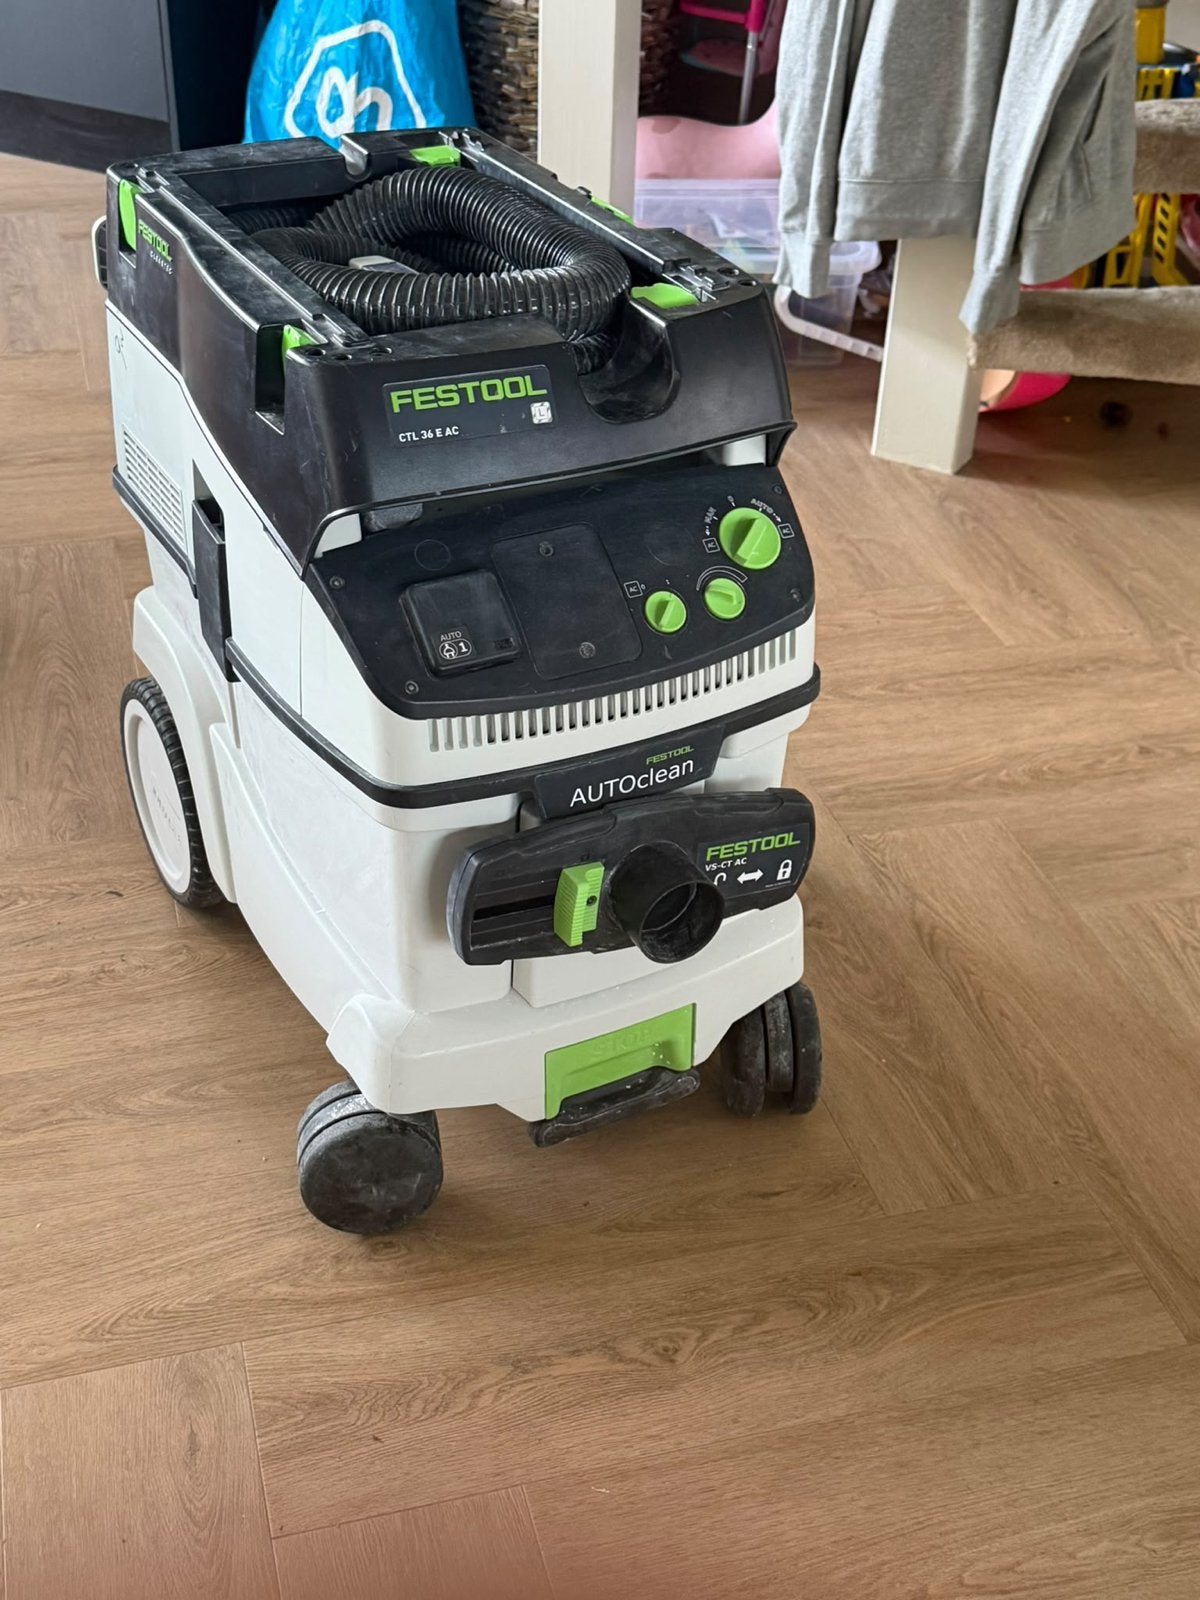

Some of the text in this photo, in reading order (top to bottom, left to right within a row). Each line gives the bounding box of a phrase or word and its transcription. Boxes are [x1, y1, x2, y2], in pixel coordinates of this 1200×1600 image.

[138, 218, 173, 262] FESTOOL
[390, 375, 548, 413] FESTOOL
[398, 426, 460, 443] CTL 36 E AC
[440, 630, 462, 642] AUTO
[459, 642, 468, 652] 1
[646, 745, 695, 765] FESTOOL
[569, 759, 695, 808] AUTOclean
[705, 831, 801, 861] FESTOOL
[705, 857, 748, 872] VS-CT AC
